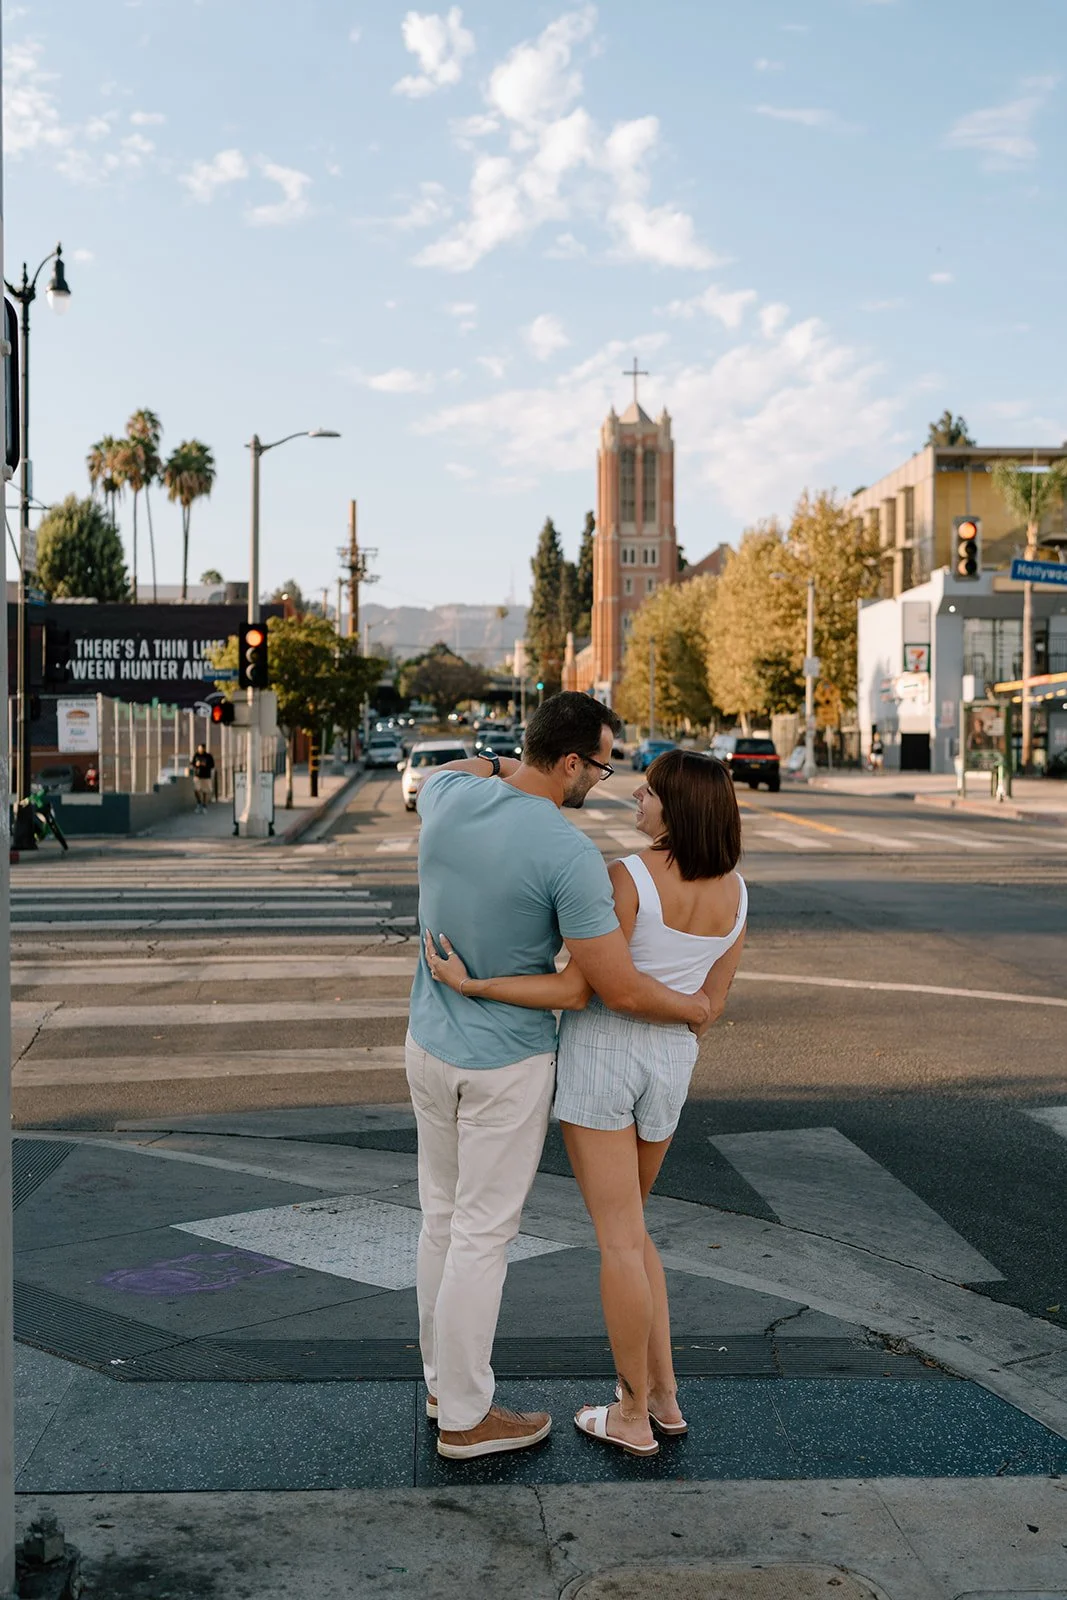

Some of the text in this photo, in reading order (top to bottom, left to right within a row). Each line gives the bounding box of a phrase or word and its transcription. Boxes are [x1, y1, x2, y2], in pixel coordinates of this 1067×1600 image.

[75, 639, 135, 659] THERE'S
[139, 639, 150, 659] A
[153, 639, 188, 659] THIN
[910, 648, 925, 672] 7
[120, 660, 178, 680] HUNTER
[113, 696, 178, 720] hulu
